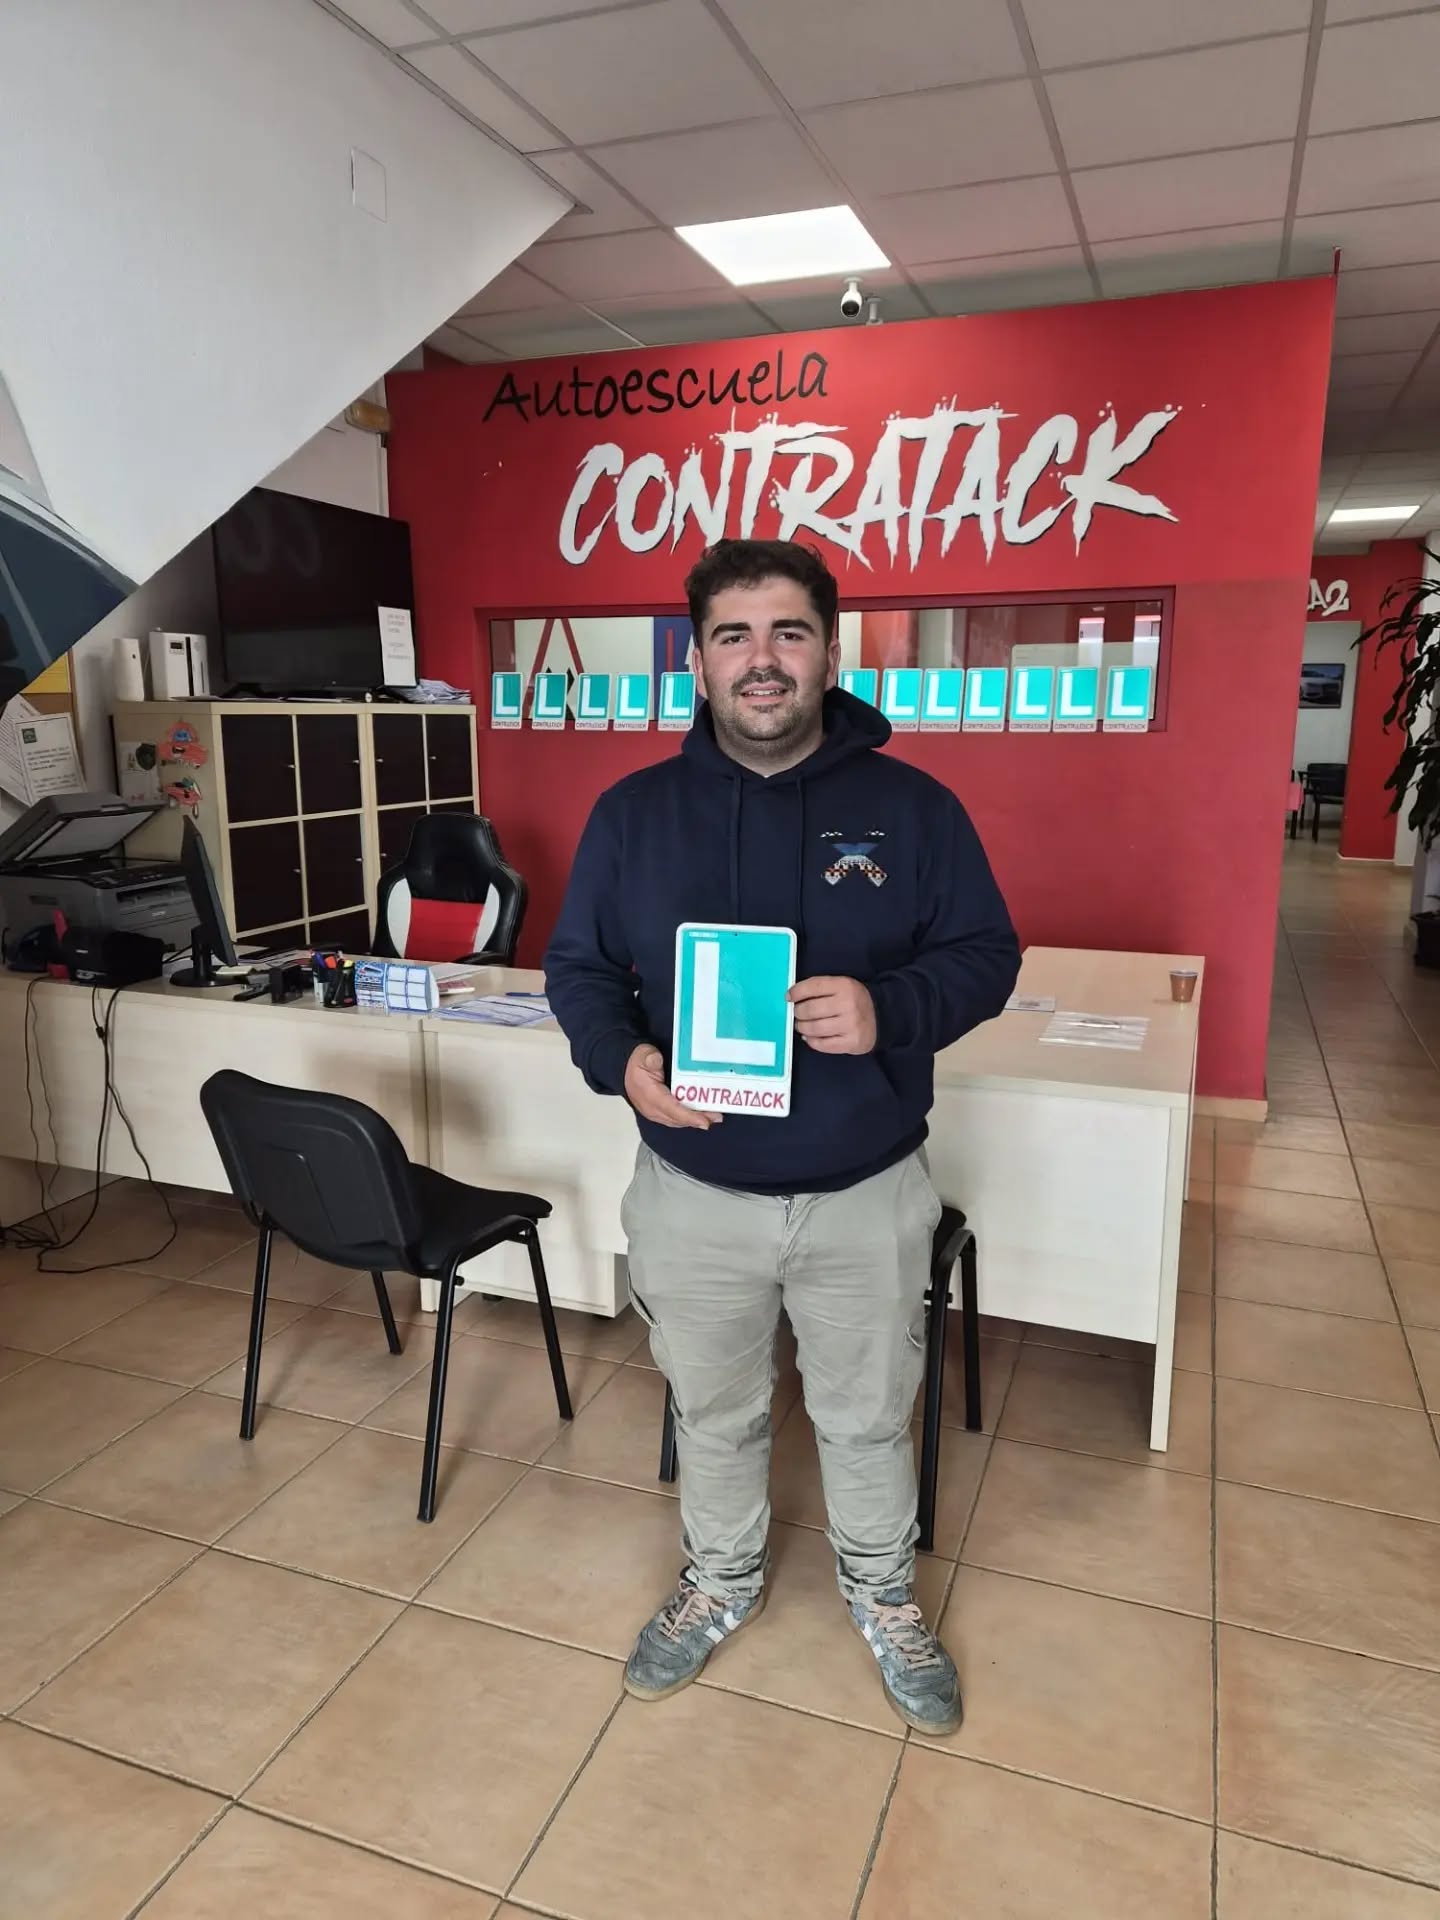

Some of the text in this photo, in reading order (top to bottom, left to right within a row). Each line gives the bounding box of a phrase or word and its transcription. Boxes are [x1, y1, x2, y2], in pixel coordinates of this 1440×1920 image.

[482, 350, 828, 423] Autoescuela
[559, 393, 1181, 573] CONTRATACK
[495, 677, 519, 715] L
[537, 677, 562, 715] L
[580, 677, 606, 716] L
[619, 677, 646, 717] L
[664, 677, 690, 716] L
[885, 672, 915, 716] L
[926, 673, 957, 716] L
[968, 673, 1000, 716] L
[1015, 671, 1047, 715] L
[1060, 672, 1093, 716] L
[1110, 671, 1144, 716] L
[691, 941, 776, 1066] L
[675, 1085, 785, 1109] CONTRATACK
